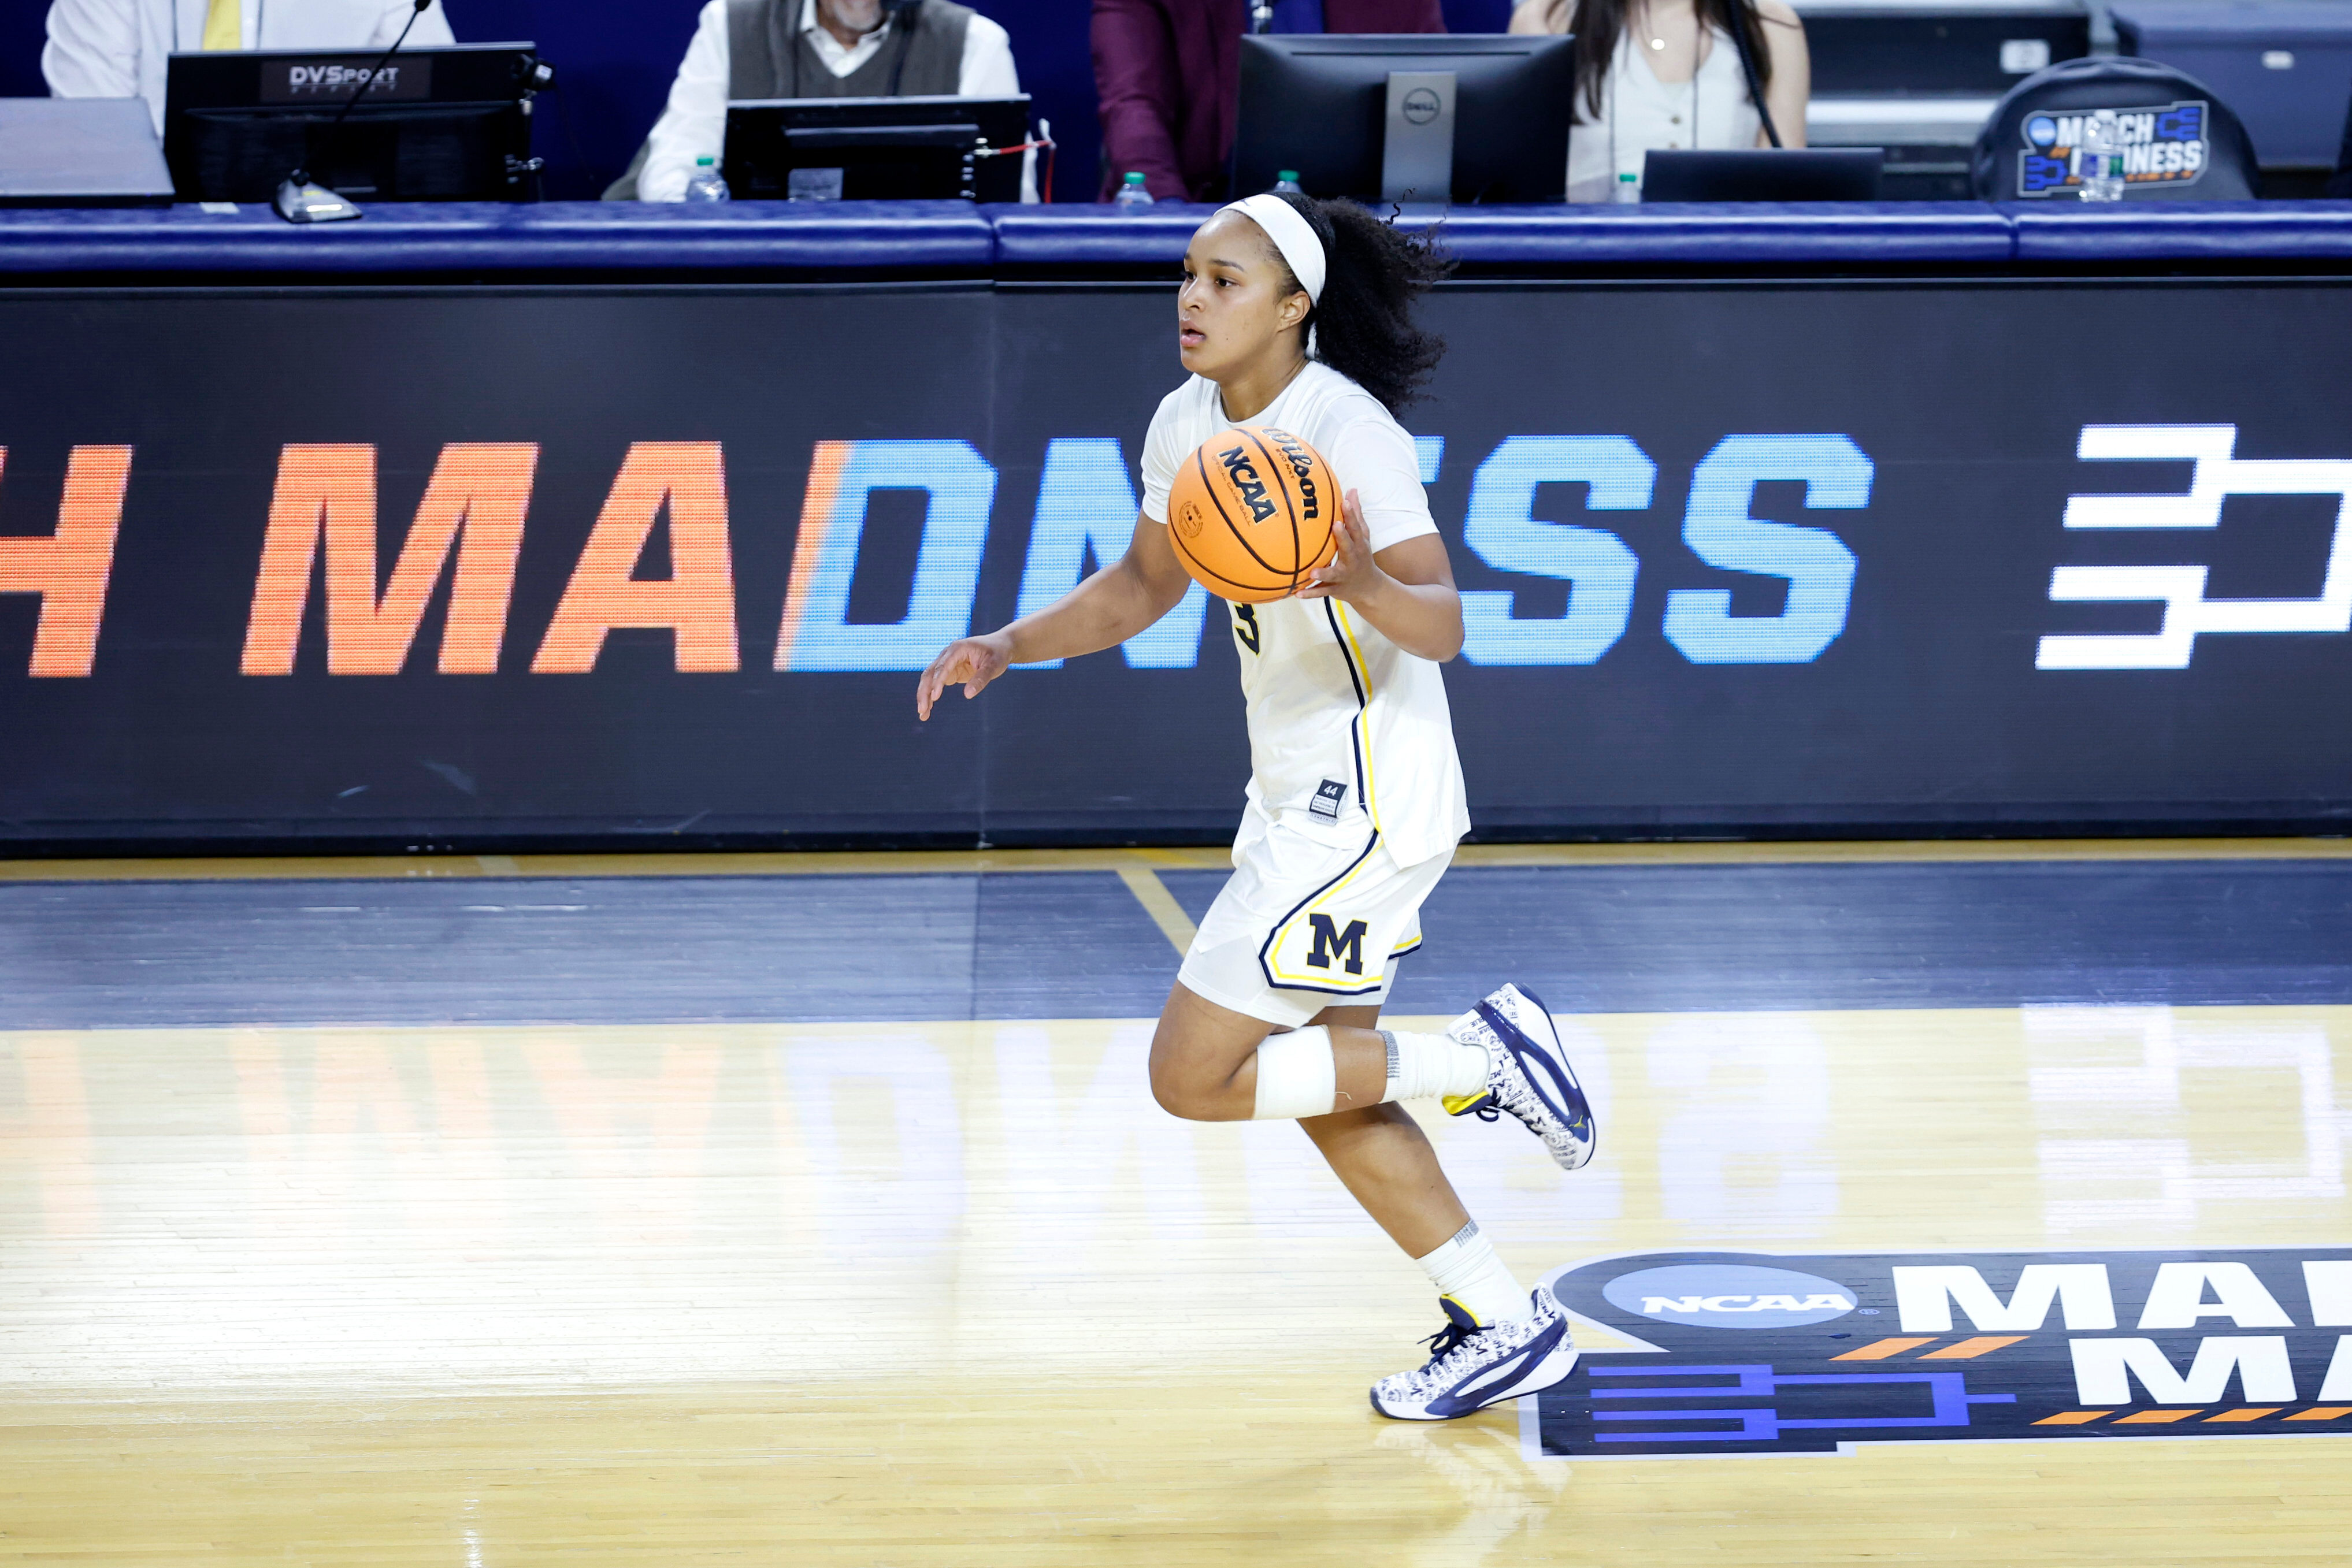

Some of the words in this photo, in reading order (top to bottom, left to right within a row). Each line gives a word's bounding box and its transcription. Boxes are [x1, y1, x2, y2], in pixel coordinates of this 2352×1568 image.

[1216, 445, 1278, 525] NCAA
[1260, 428, 1319, 521] Wilson
[1275, 448, 1287, 462] EVO
[1285, 463, 1296, 480] NXT
[1226, 481, 1241, 504] GAME
[1239, 504, 1251, 527] BALL
[239, 433, 1875, 677] MADNSS
[1323, 785, 1338, 796] 44
[1307, 913, 1369, 976] M
[1641, 1294, 1856, 1313] NCAA
[2068, 1334, 2352, 1406] M
